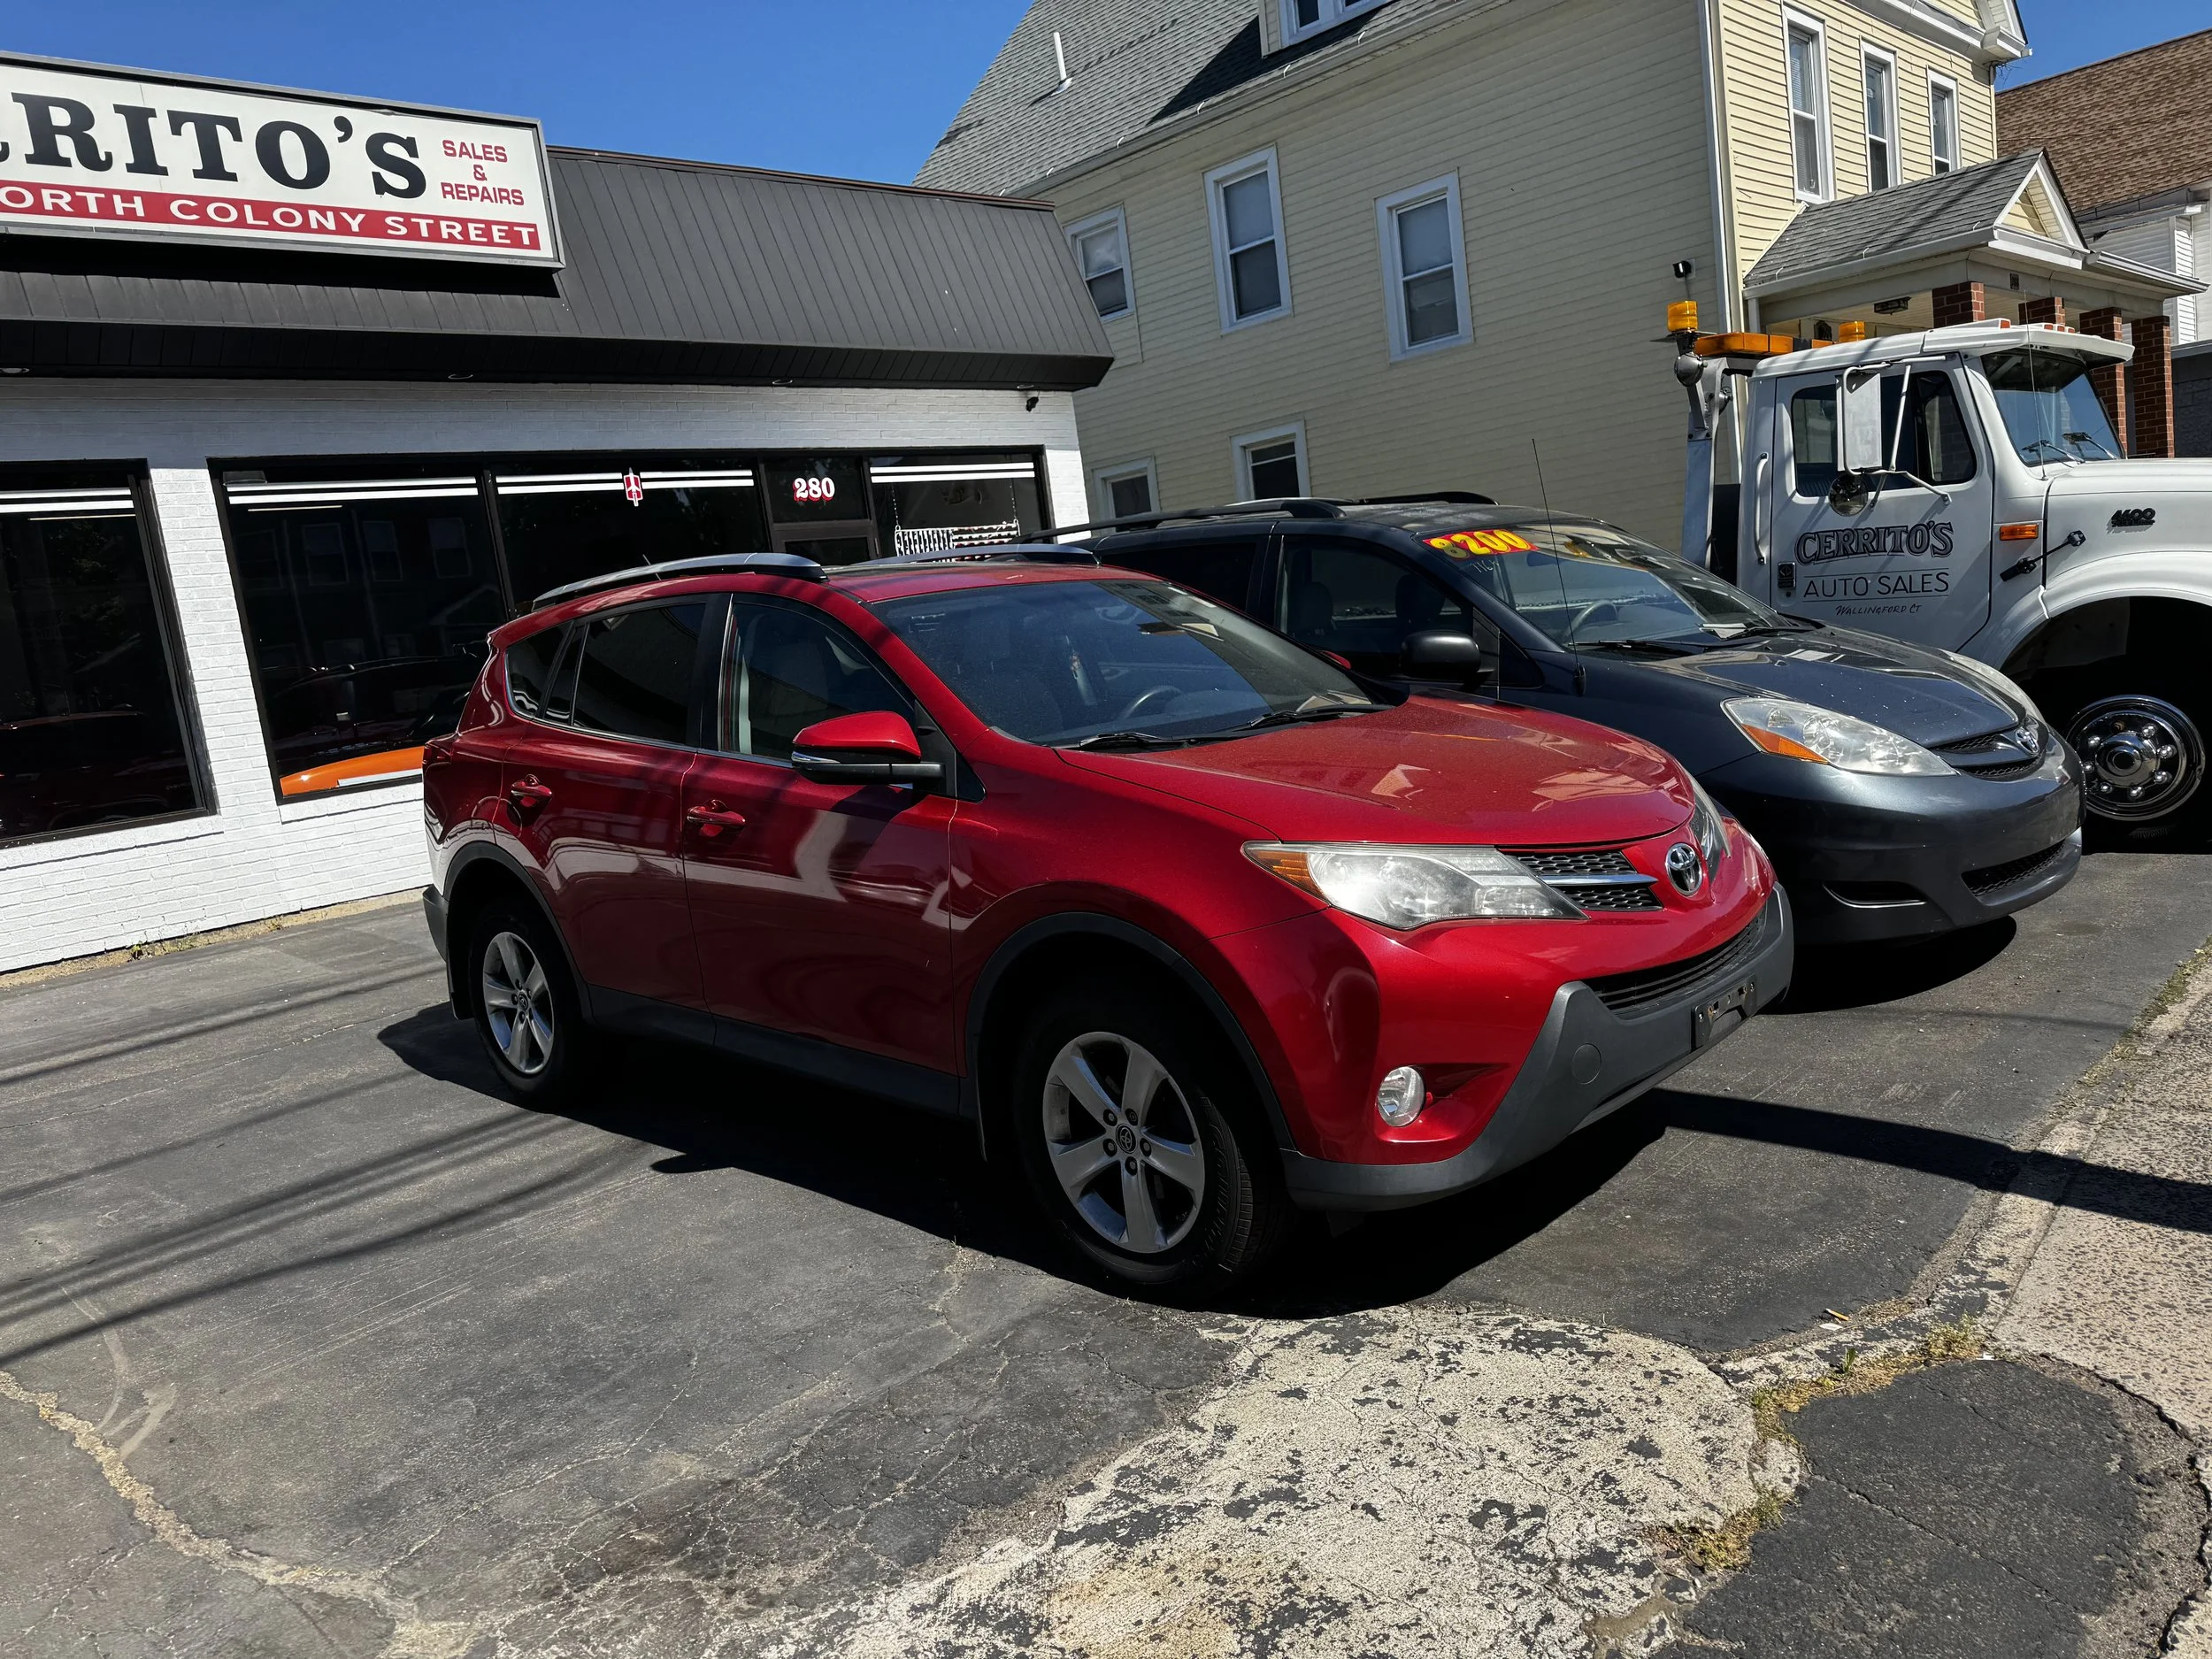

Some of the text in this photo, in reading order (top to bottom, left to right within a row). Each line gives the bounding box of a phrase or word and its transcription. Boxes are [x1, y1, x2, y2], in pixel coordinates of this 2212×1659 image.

[0, 92, 426, 199] RITO'S
[442, 139, 508, 163] SALES
[472, 165, 488, 181] &
[441, 182, 525, 206] REPAIRS
[169, 199, 365, 233] COLONY
[387, 216, 535, 245] STREET
[793, 478, 835, 502] 280
[1794, 519, 1954, 566] CERRITO'S
[1803, 572, 1949, 598] AUTO SALES
[1835, 604, 1907, 617] WALLINGFORD
